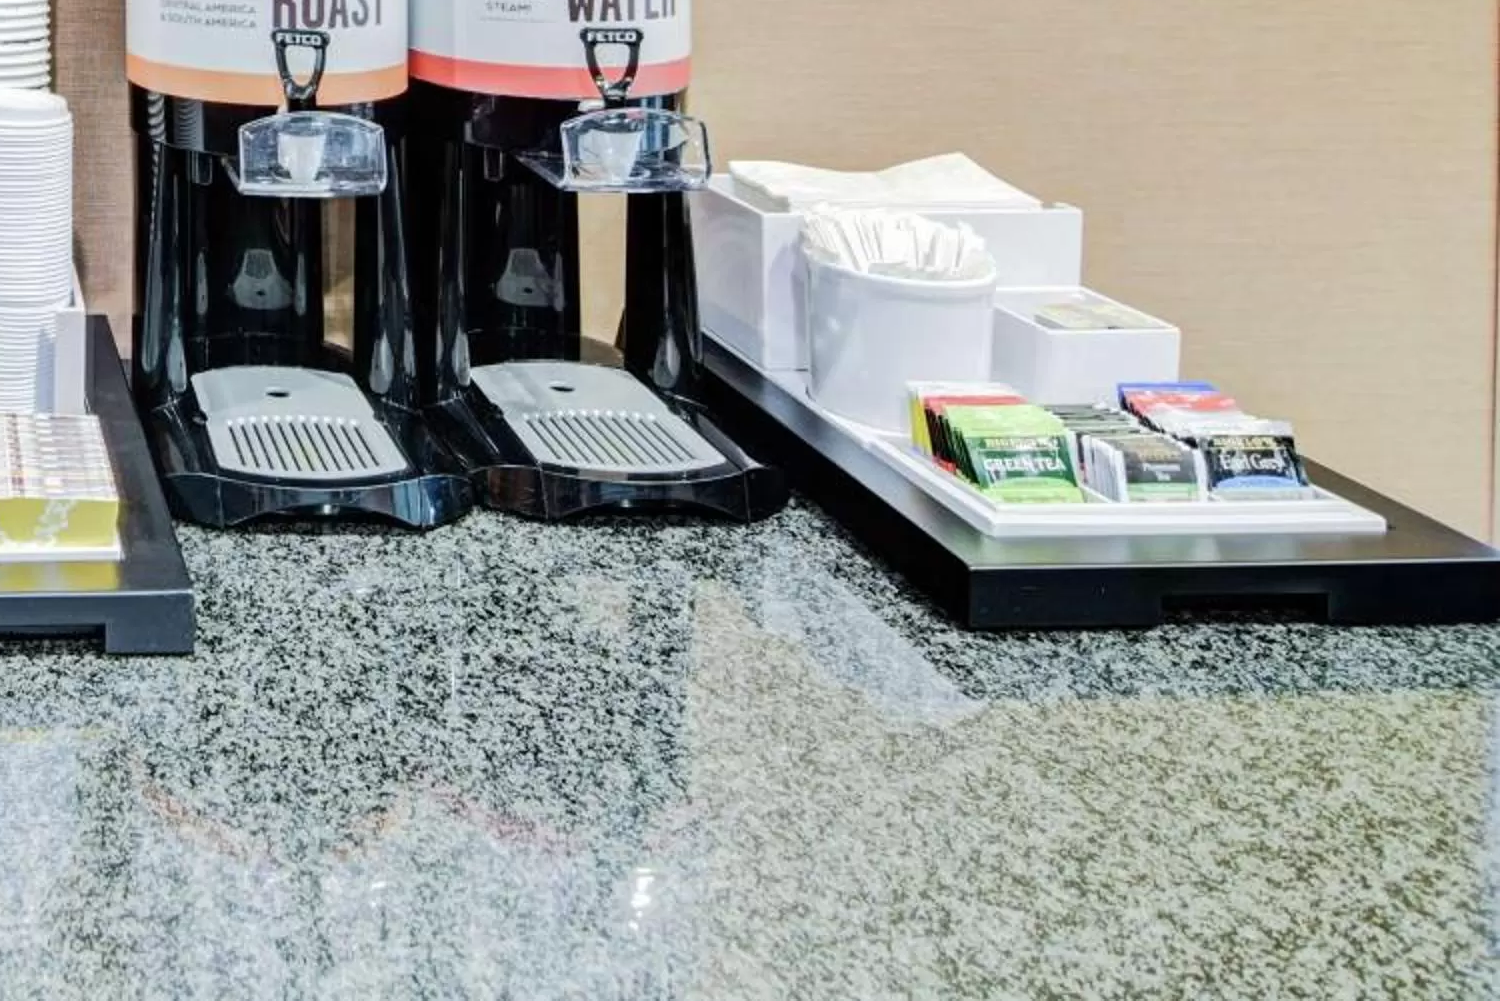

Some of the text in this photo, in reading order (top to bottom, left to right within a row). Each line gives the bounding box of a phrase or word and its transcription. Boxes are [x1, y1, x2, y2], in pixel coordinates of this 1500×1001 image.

[276, 32, 321, 45] FETCO
[587, 31, 636, 42] FETCO
[983, 454, 1067, 474] GREEN TEA
